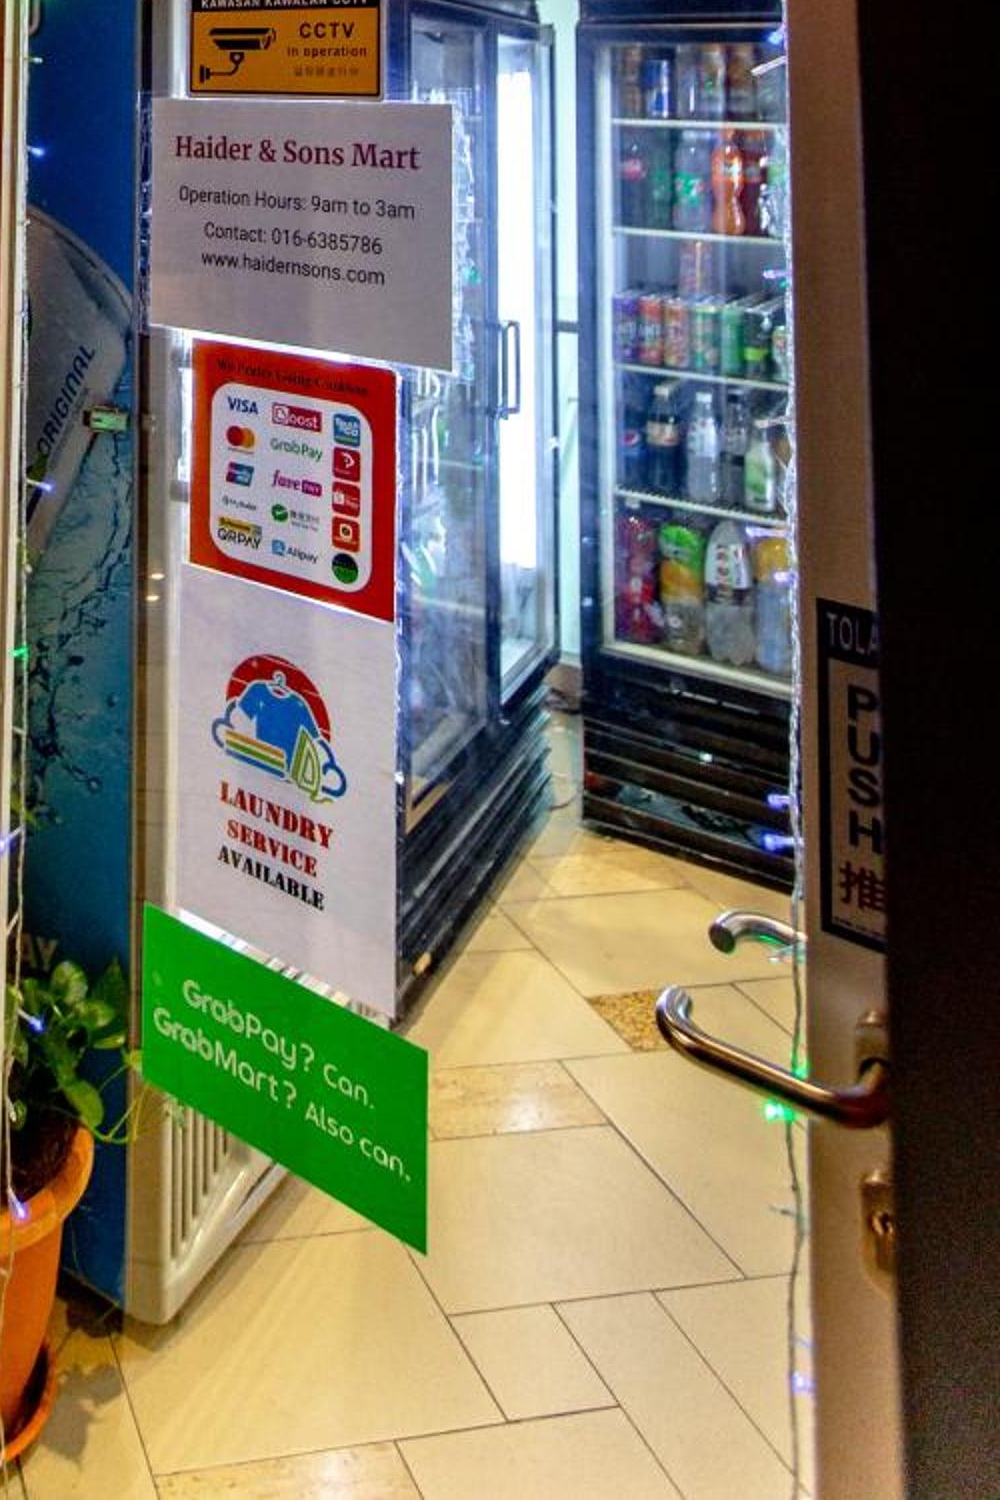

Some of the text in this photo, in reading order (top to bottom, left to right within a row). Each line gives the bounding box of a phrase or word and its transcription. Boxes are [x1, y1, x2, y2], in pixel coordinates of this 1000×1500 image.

[299, 21, 356, 39] CCTV
[302, 46, 367, 59] operation
[175, 135, 422, 171] Haider & Sons Mart
[179, 185, 416, 221] Operation Hours: 9am to 3am
[204, 221, 383, 255] Contact: 016-6385786
[38, 346, 96, 454] ORIGINAL
[227, 396, 259, 415] VISA
[270, 437, 323, 461] GrabPay
[847, 684, 884, 855] PUSH
[221, 781, 333, 848] LAUNDRY
[227, 819, 318, 878] SERVICE
[218, 845, 324, 911] AVAILABLE
[839, 860, 888, 913] 推
[183, 979, 376, 1110] GrabPay? Can.
[153, 1007, 411, 1183] GrabMart? Also can.
